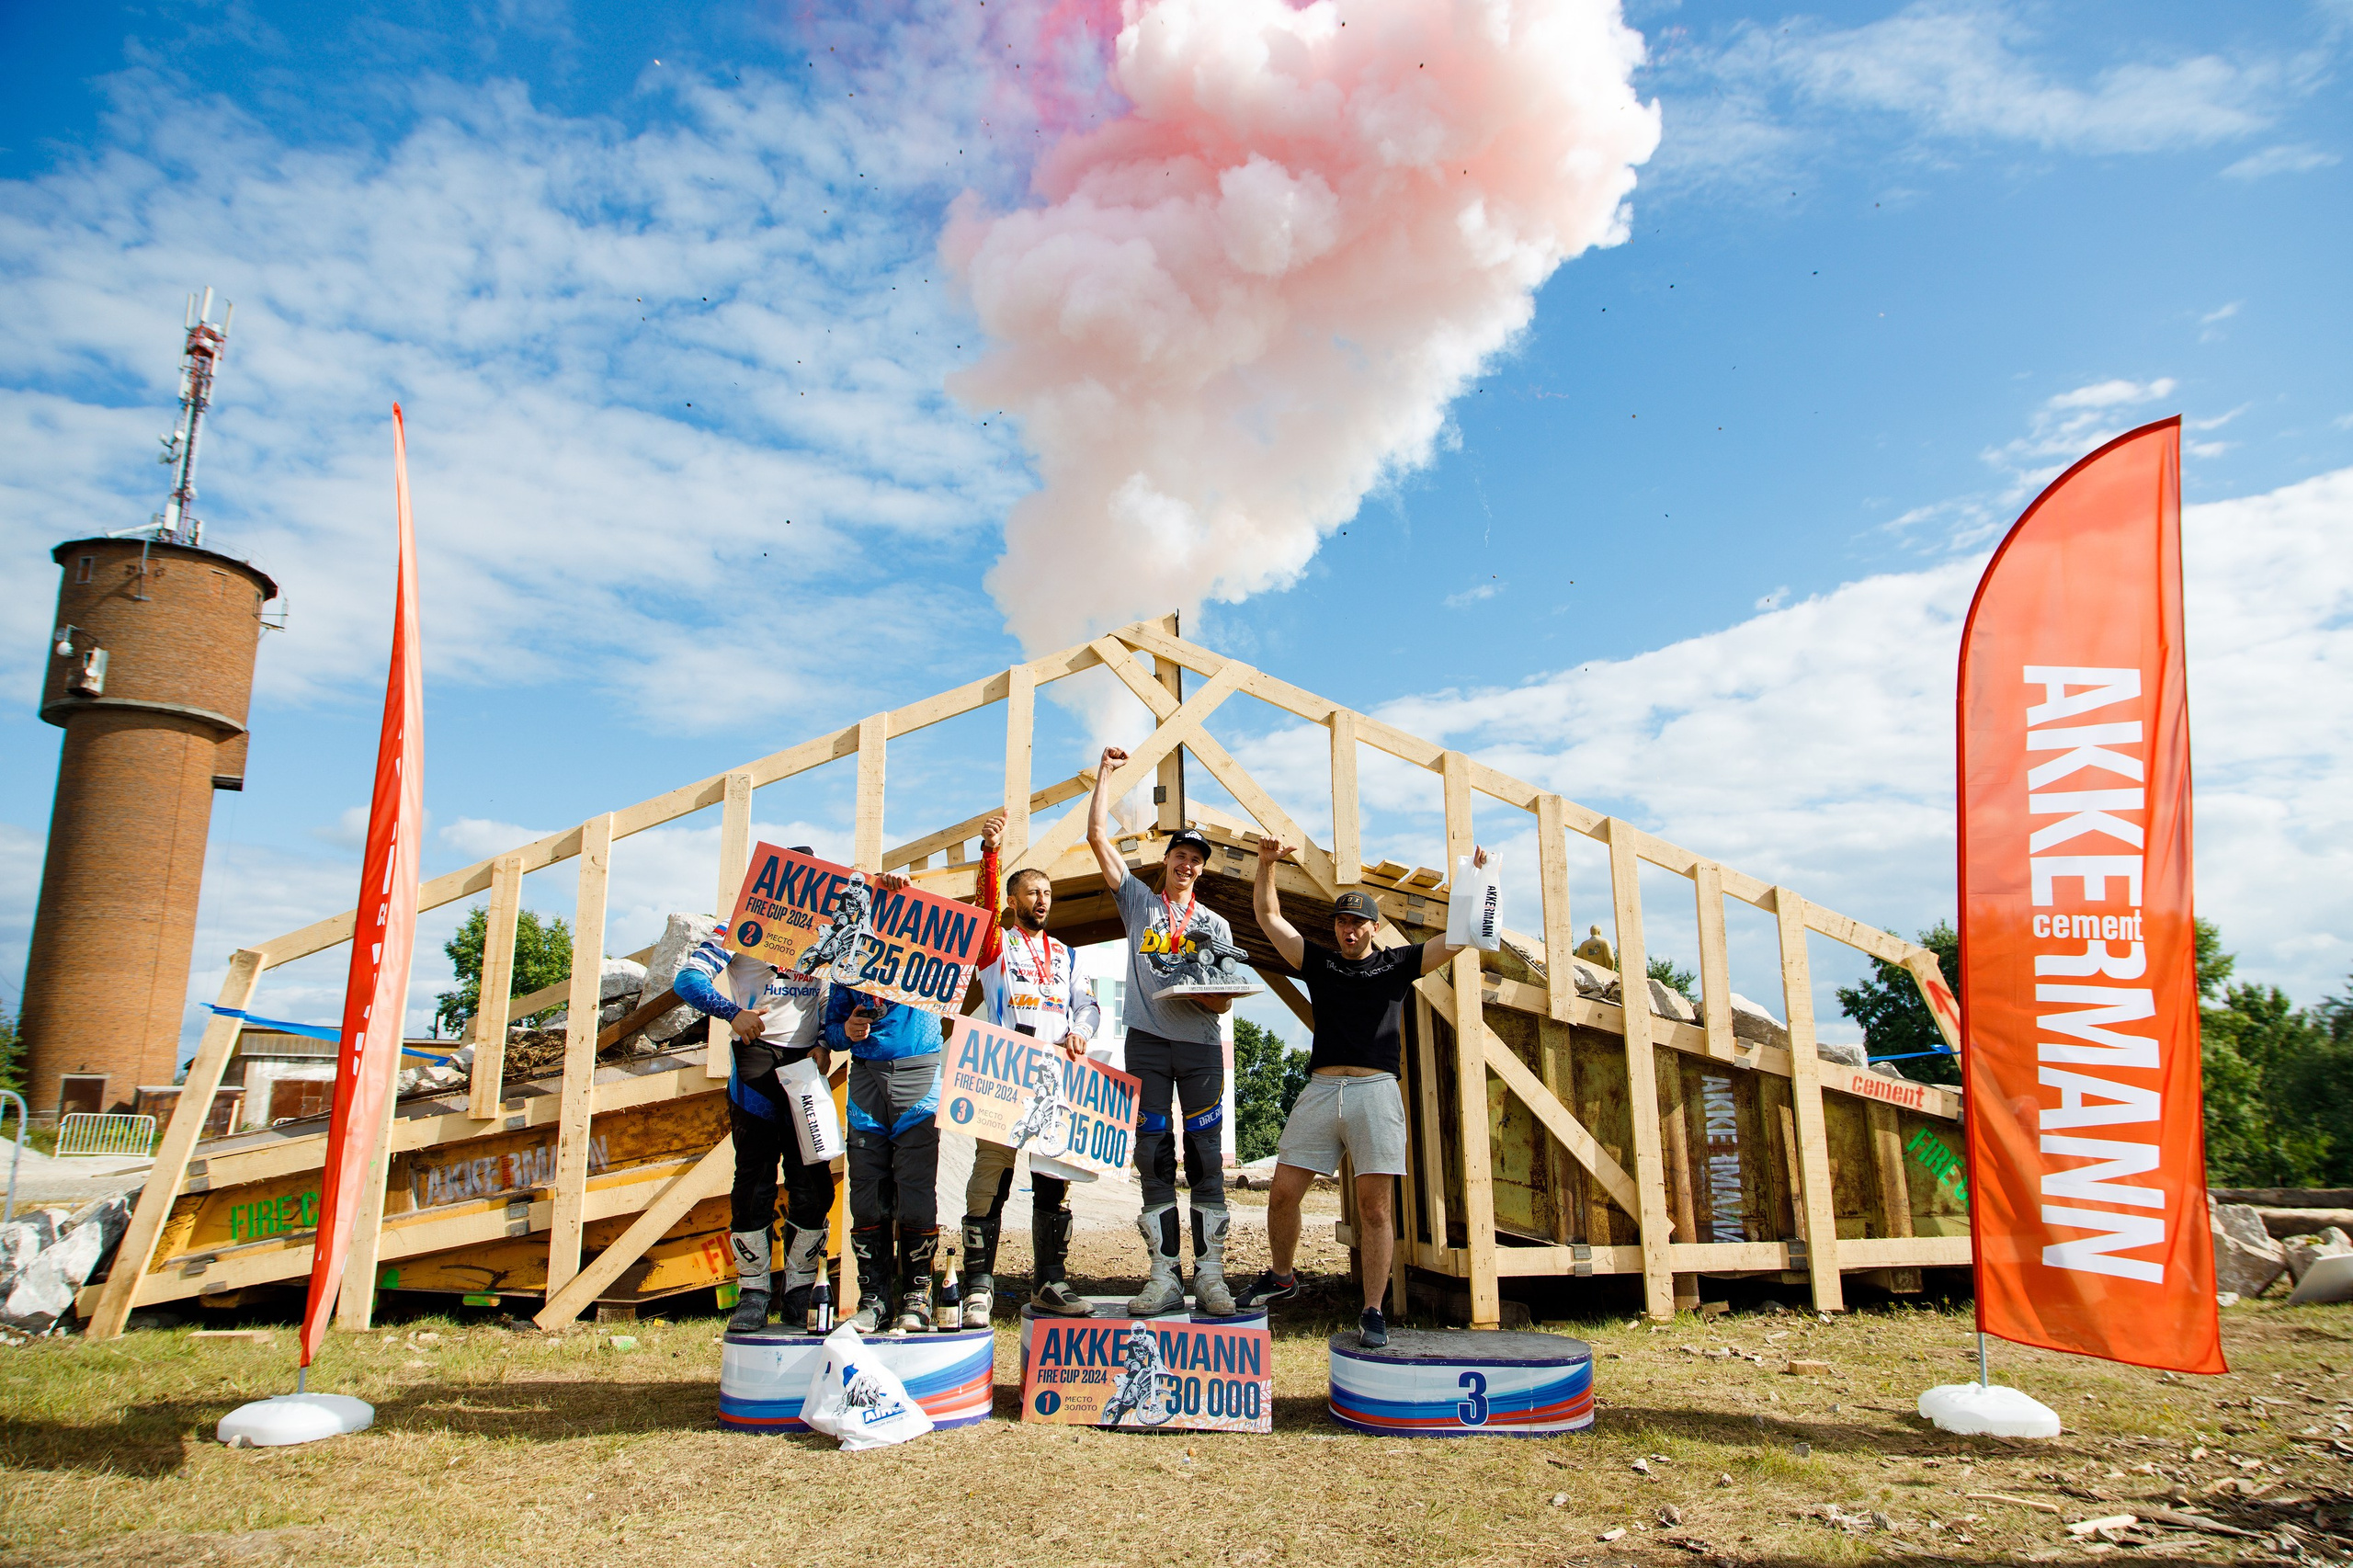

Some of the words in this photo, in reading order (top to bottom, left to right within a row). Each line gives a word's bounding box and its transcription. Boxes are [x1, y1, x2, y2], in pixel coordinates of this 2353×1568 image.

[745, 896, 768, 917] FIRE
[767, 903, 788, 924] CUP
[787, 909, 813, 930] 2024
[751, 855, 978, 959] AKKEMANN
[744, 924, 756, 944] 2
[767, 932, 793, 946] МЕСТО
[2032, 907, 2143, 943] cement
[763, 941, 796, 957] ЗОЛОТО
[859, 940, 904, 986] 25
[901, 950, 961, 1003] 000
[1007, 994, 1040, 1006] KTM
[1041, 1003, 1055, 1012] Red
[954, 1072, 974, 1090] FIRE
[975, 1078, 994, 1096] CUP
[995, 1084, 1017, 1103] 2024
[957, 1028, 1134, 1124] AKKEMANN
[1851, 1075, 1925, 1108] cement
[957, 1100, 967, 1121] 3
[976, 1117, 1006, 1131] ЗОЛОТО
[978, 1108, 1003, 1121] МЕСТО
[1068, 1111, 1090, 1155] 15
[1090, 1120, 1128, 1168] 000
[1906, 1127, 1964, 1187] FIRE
[231, 1192, 293, 1241] FIRE
[1040, 1327, 1261, 1376] AKKEMANN
[1037, 1369, 1059, 1384] FIRE
[1060, 1369, 1081, 1384] CUP
[1082, 1369, 1108, 1384] 2024
[1043, 1394, 1051, 1413] 1
[1063, 1403, 1097, 1412] ЗОЛОТО
[1064, 1396, 1093, 1404] МЕСТО
[1165, 1375, 1201, 1415] 30
[1207, 1378, 1261, 1420] 000
[1458, 1371, 1489, 1426] 3
